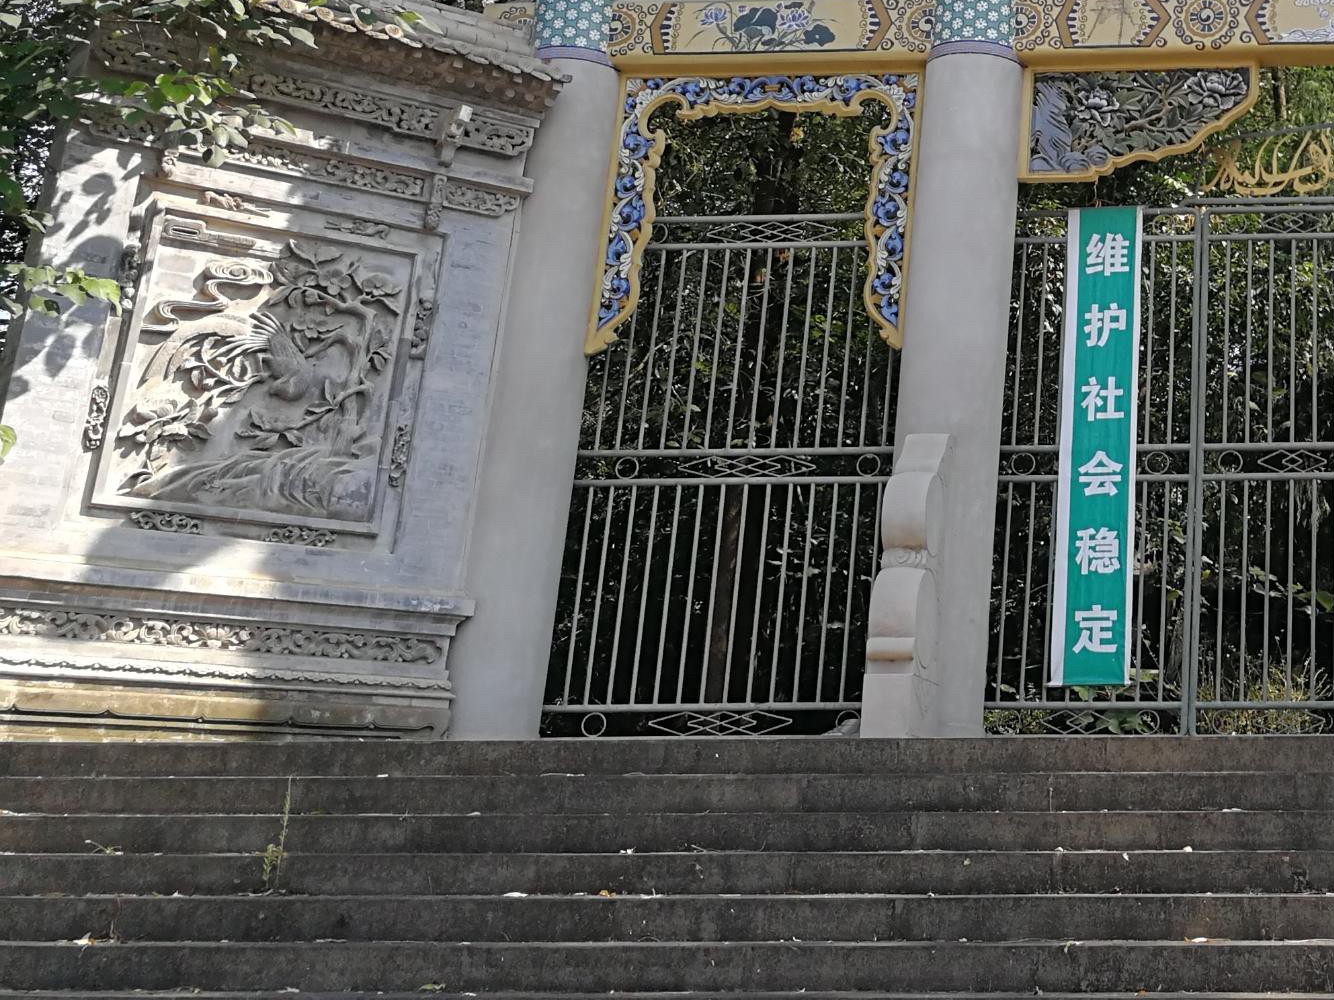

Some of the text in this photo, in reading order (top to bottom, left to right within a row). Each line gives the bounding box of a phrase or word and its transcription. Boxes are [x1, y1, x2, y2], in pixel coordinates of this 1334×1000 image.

[1072, 232, 1130, 655] 维护社会稳定
